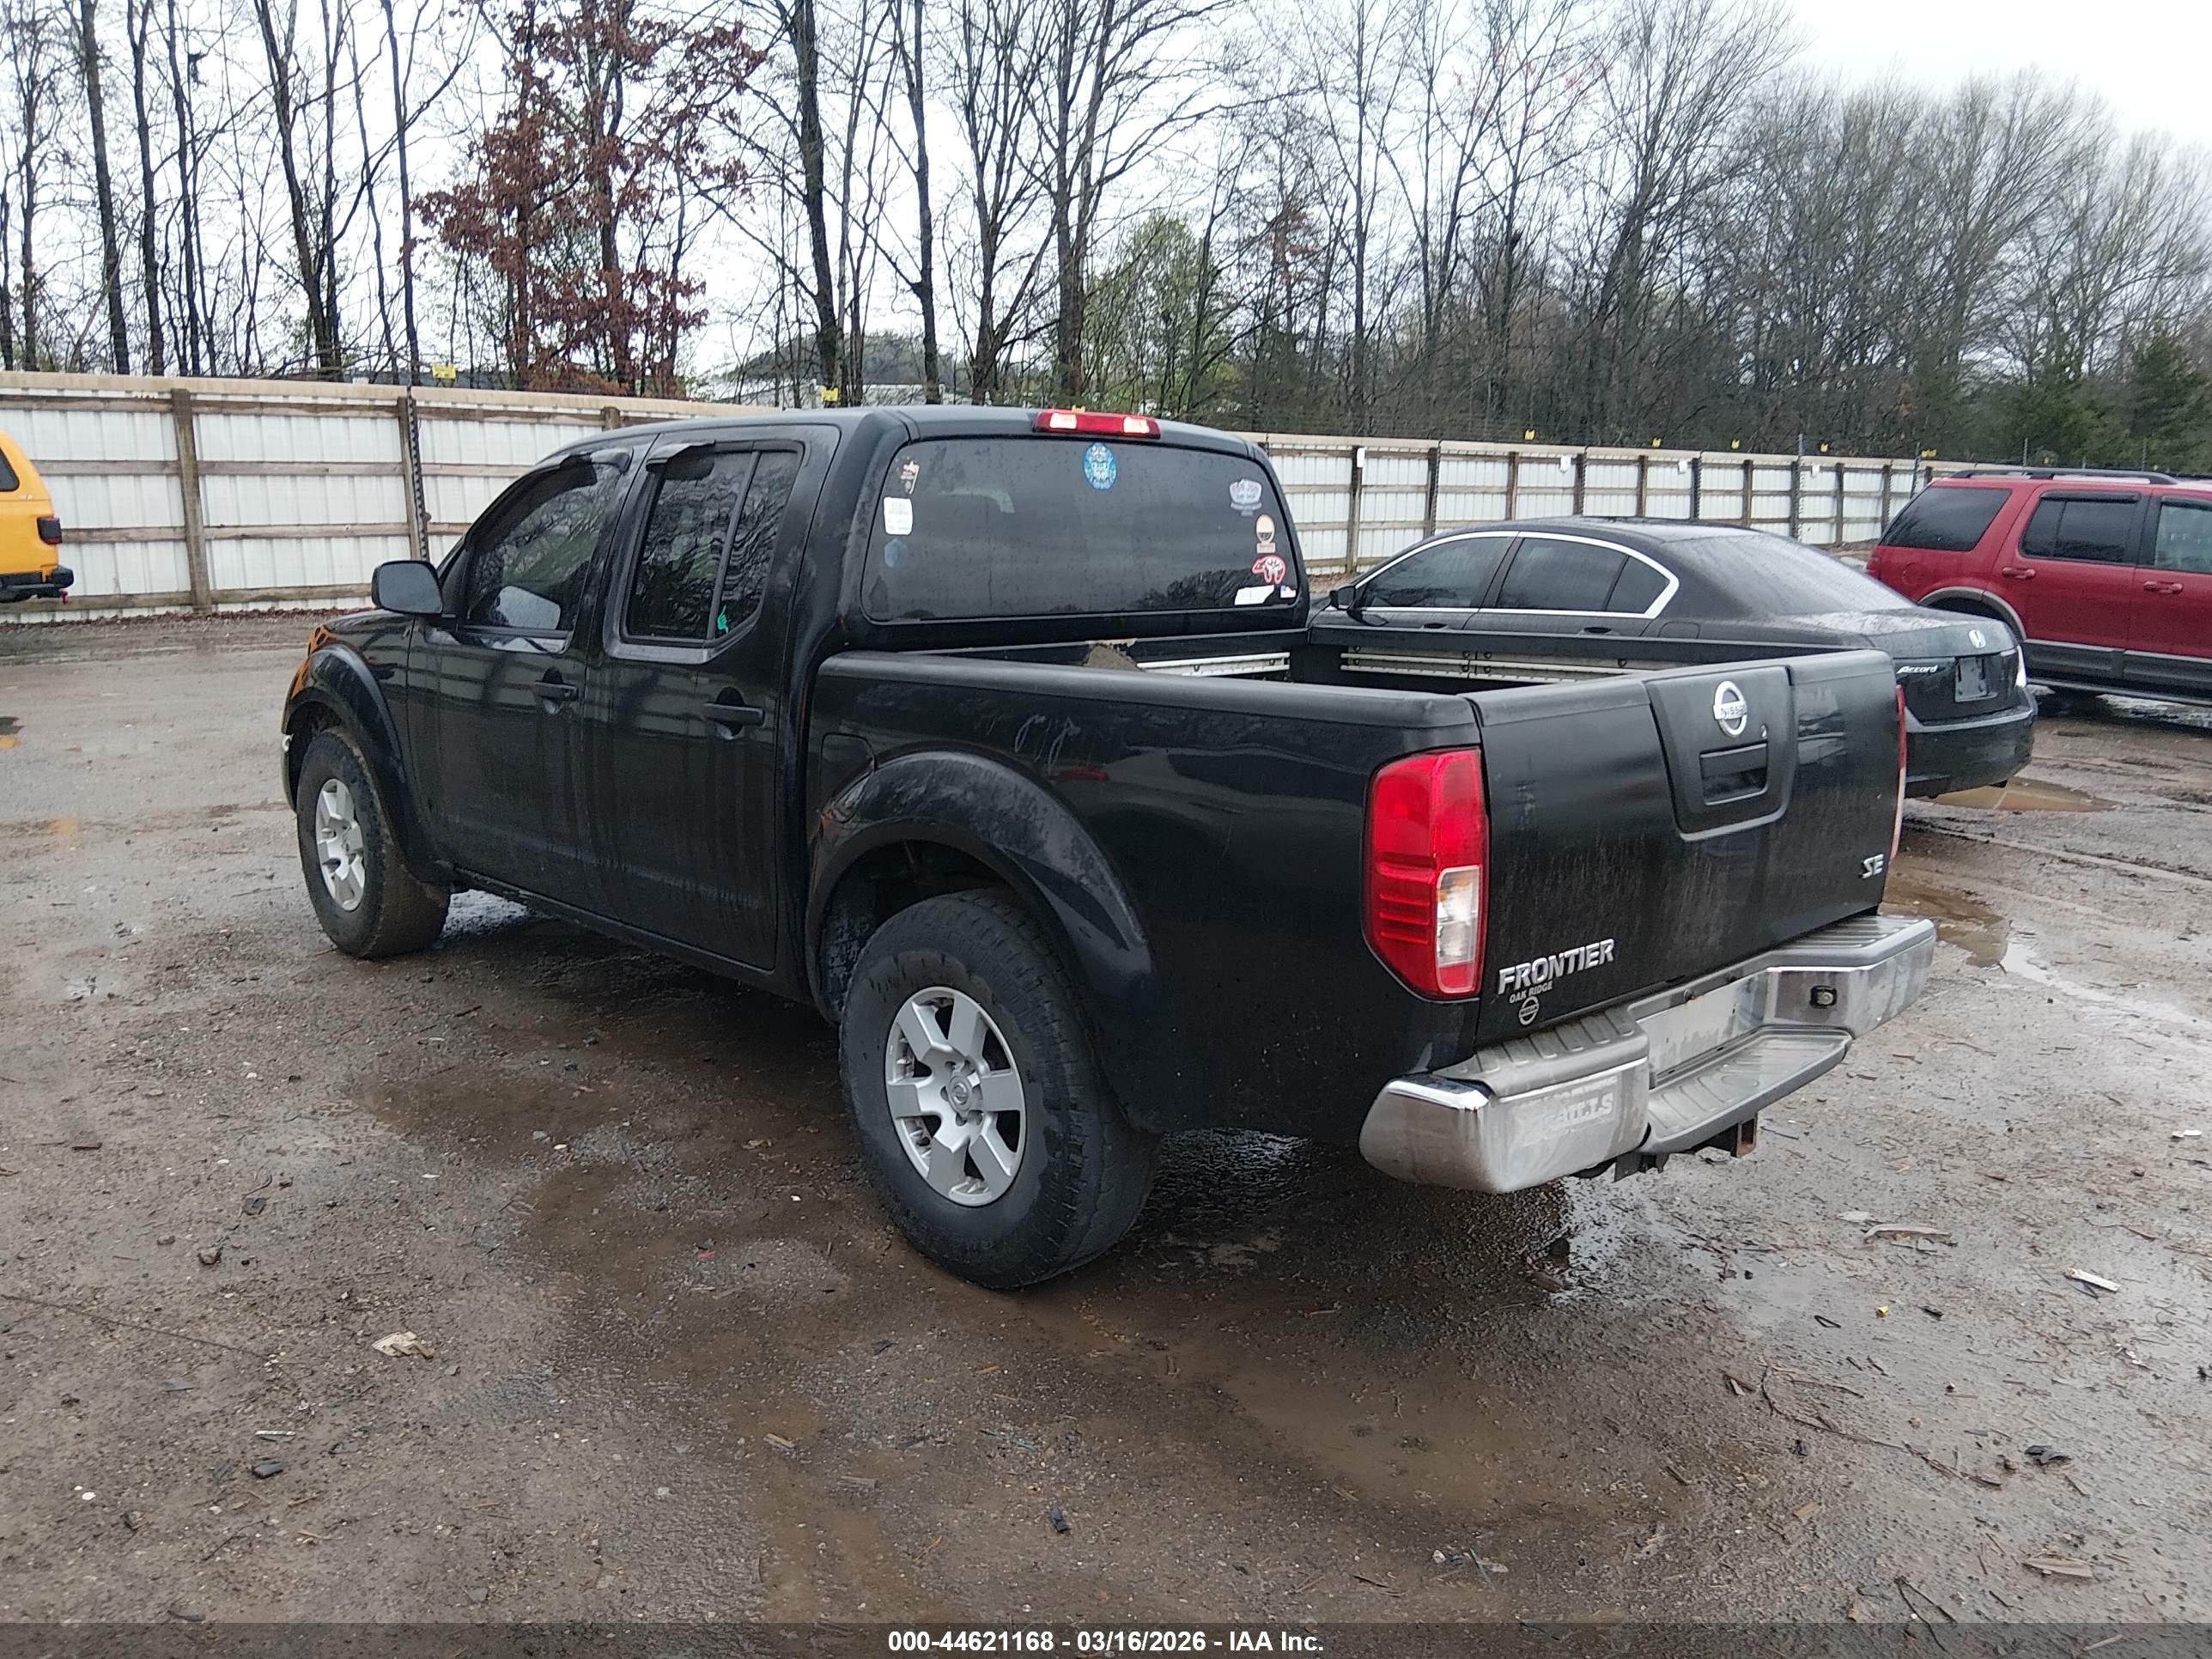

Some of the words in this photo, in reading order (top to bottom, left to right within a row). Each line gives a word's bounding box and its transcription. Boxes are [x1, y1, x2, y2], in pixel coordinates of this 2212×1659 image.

[1896, 665, 1938, 675] Accord
[1863, 854, 1884, 879] SE
[1497, 939, 1614, 995] FRONTIER
[1509, 989, 1528, 1004] OAK
[1528, 981, 1553, 997] RIDGE
